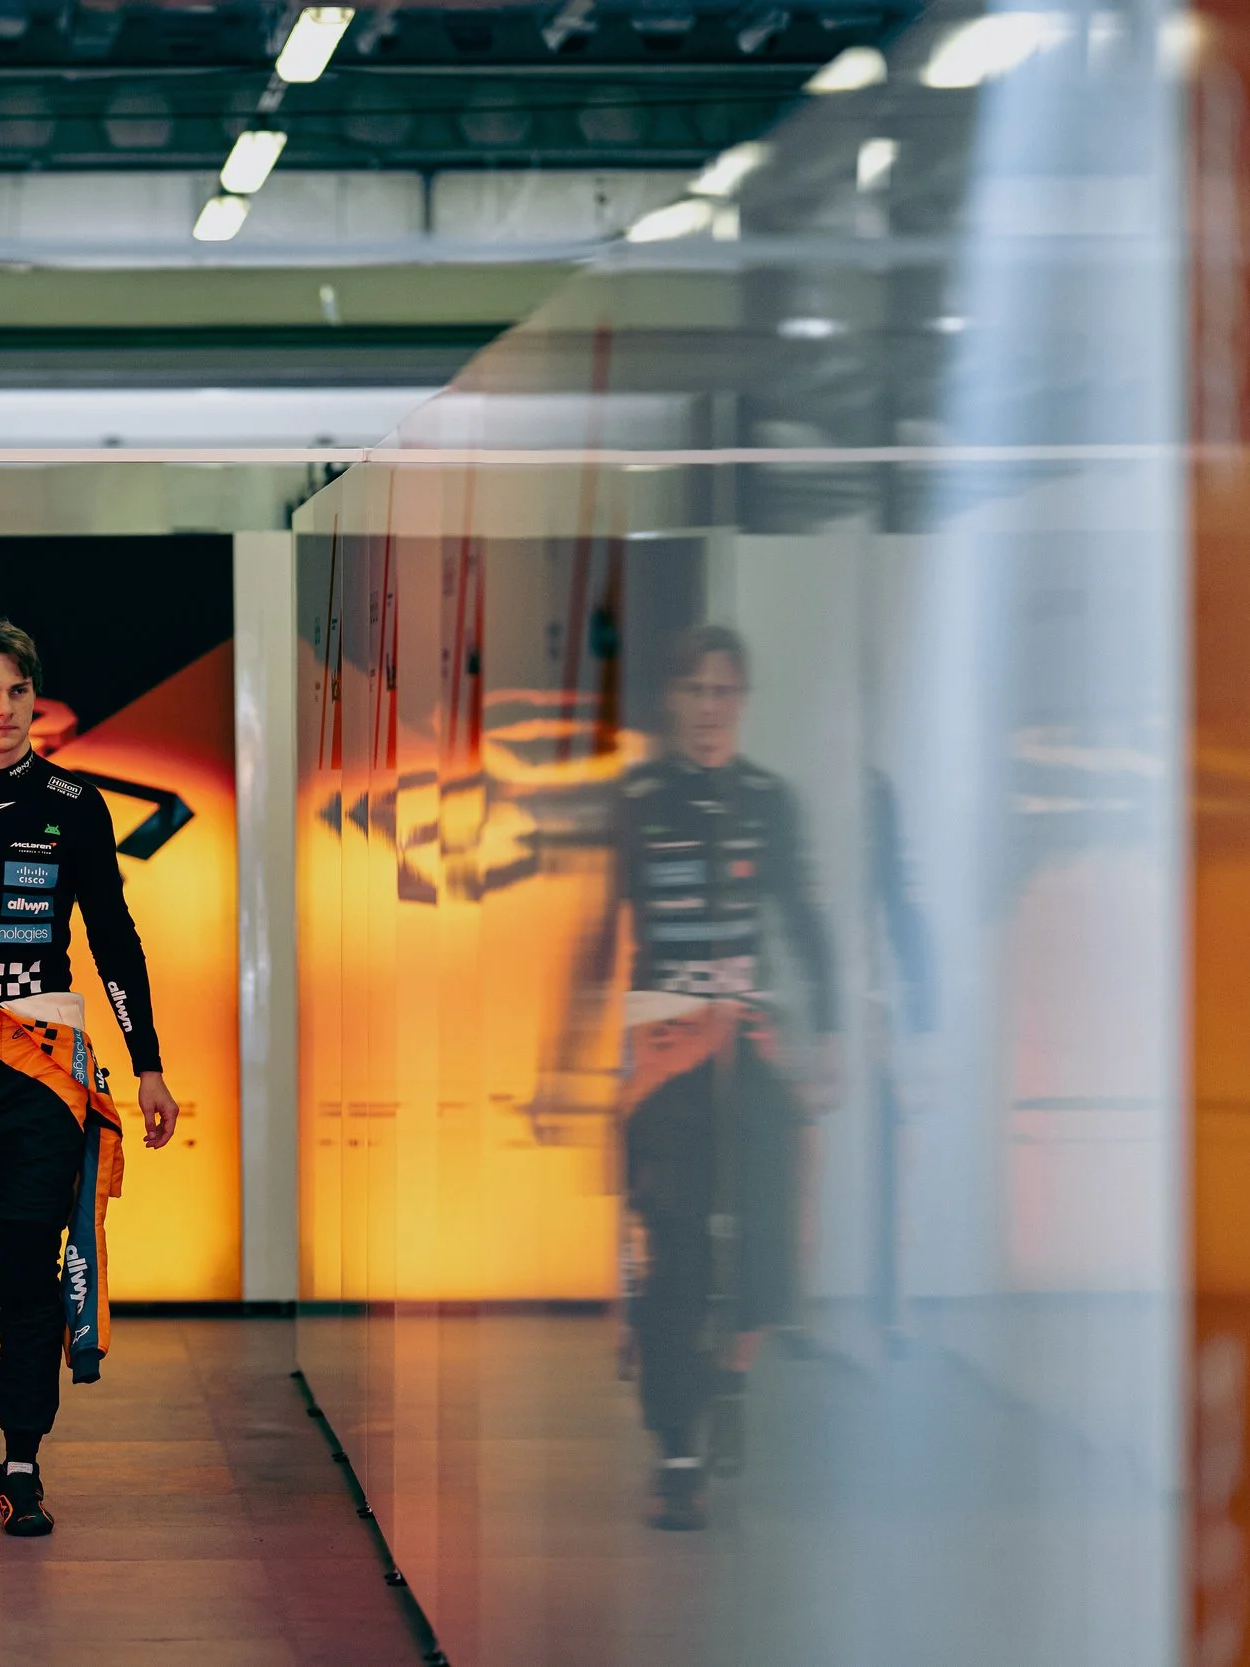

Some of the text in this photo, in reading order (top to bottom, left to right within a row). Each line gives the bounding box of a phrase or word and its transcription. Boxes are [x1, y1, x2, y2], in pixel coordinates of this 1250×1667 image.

[51, 779, 78, 793] Hilton
[10, 842, 52, 850] McLaren
[18, 876, 45, 884] CISCO
[7, 897, 50, 915] allwyn
[107, 981, 133, 1033] allwyn
